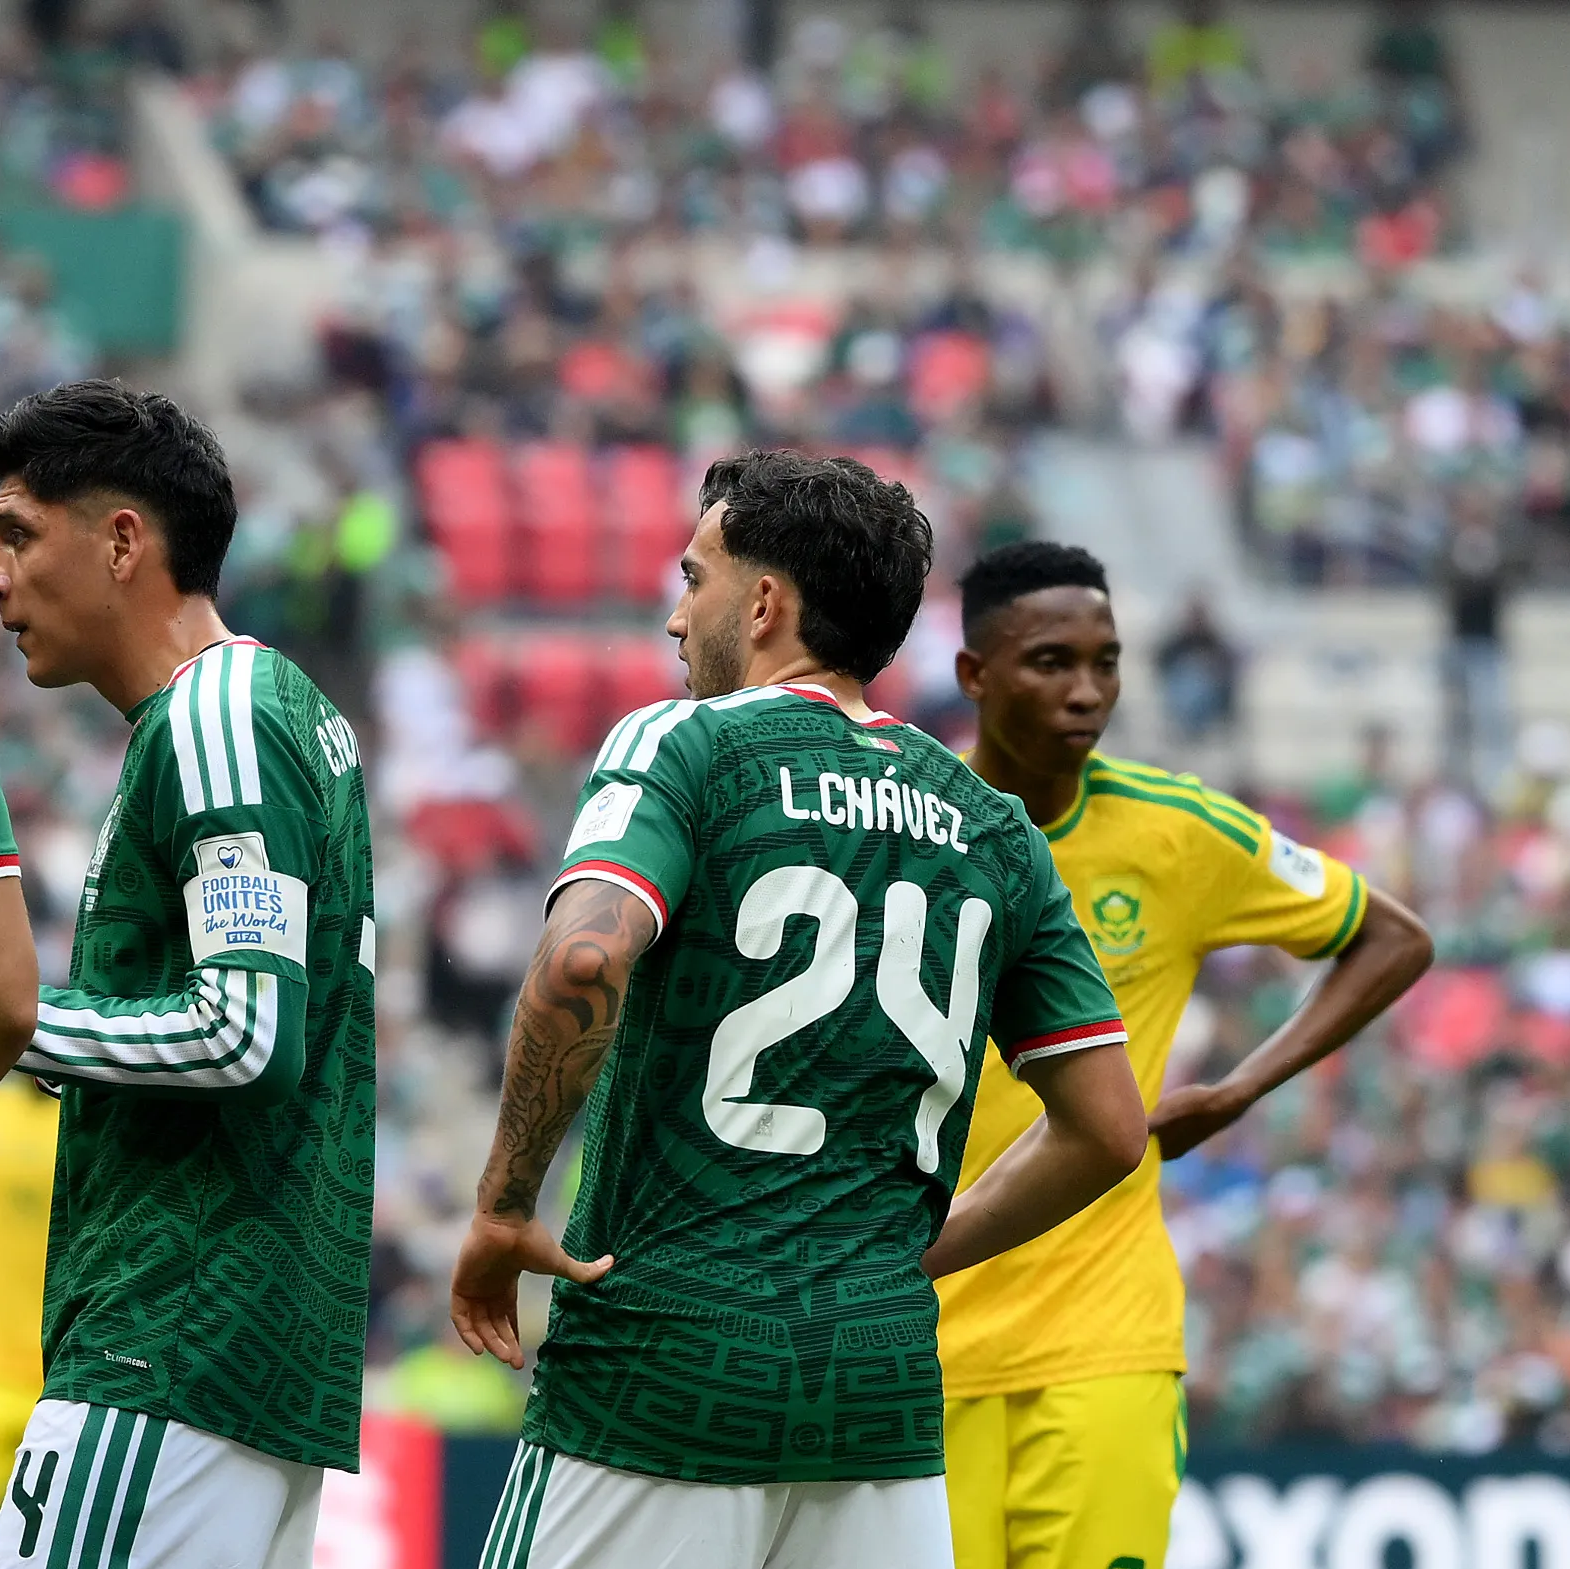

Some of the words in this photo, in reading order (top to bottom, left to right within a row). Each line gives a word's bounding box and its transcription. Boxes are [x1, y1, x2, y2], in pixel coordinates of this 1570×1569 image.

[779, 765, 969, 855] L.CHÁVEZ
[202, 876, 282, 895] FOOTBALL
[203, 890, 282, 914] UNITES
[202, 915, 229, 934] the
[232, 912, 287, 936] World
[228, 932, 259, 942] FIFA
[702, 865, 993, 1174] 24
[11, 1450, 60, 1558] 4
